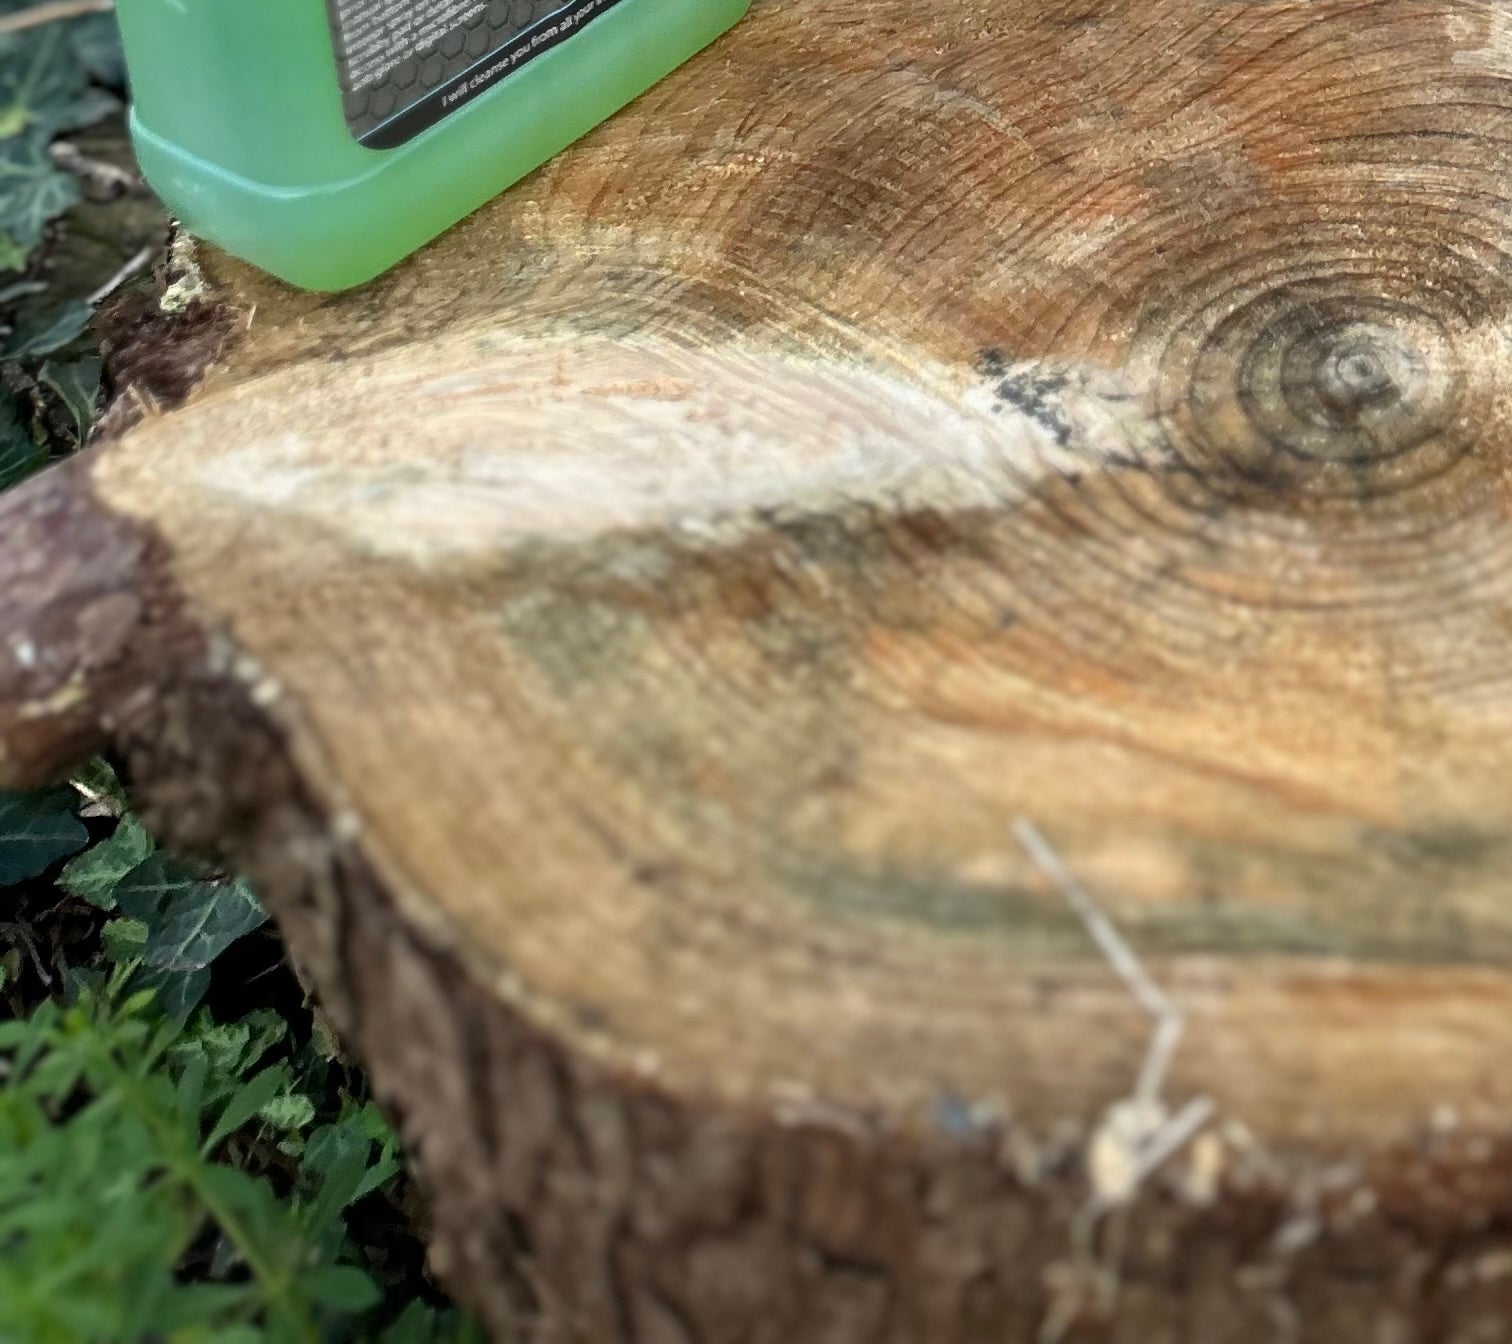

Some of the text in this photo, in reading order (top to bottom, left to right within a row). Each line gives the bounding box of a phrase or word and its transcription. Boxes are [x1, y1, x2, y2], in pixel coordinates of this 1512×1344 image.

[448, 82, 467, 101] will
[470, 58, 509, 88] cleanse
[510, 44, 530, 64] you
[531, 27, 558, 47] from
[560, 16, 572, 31] all
[573, 1, 594, 24] your
